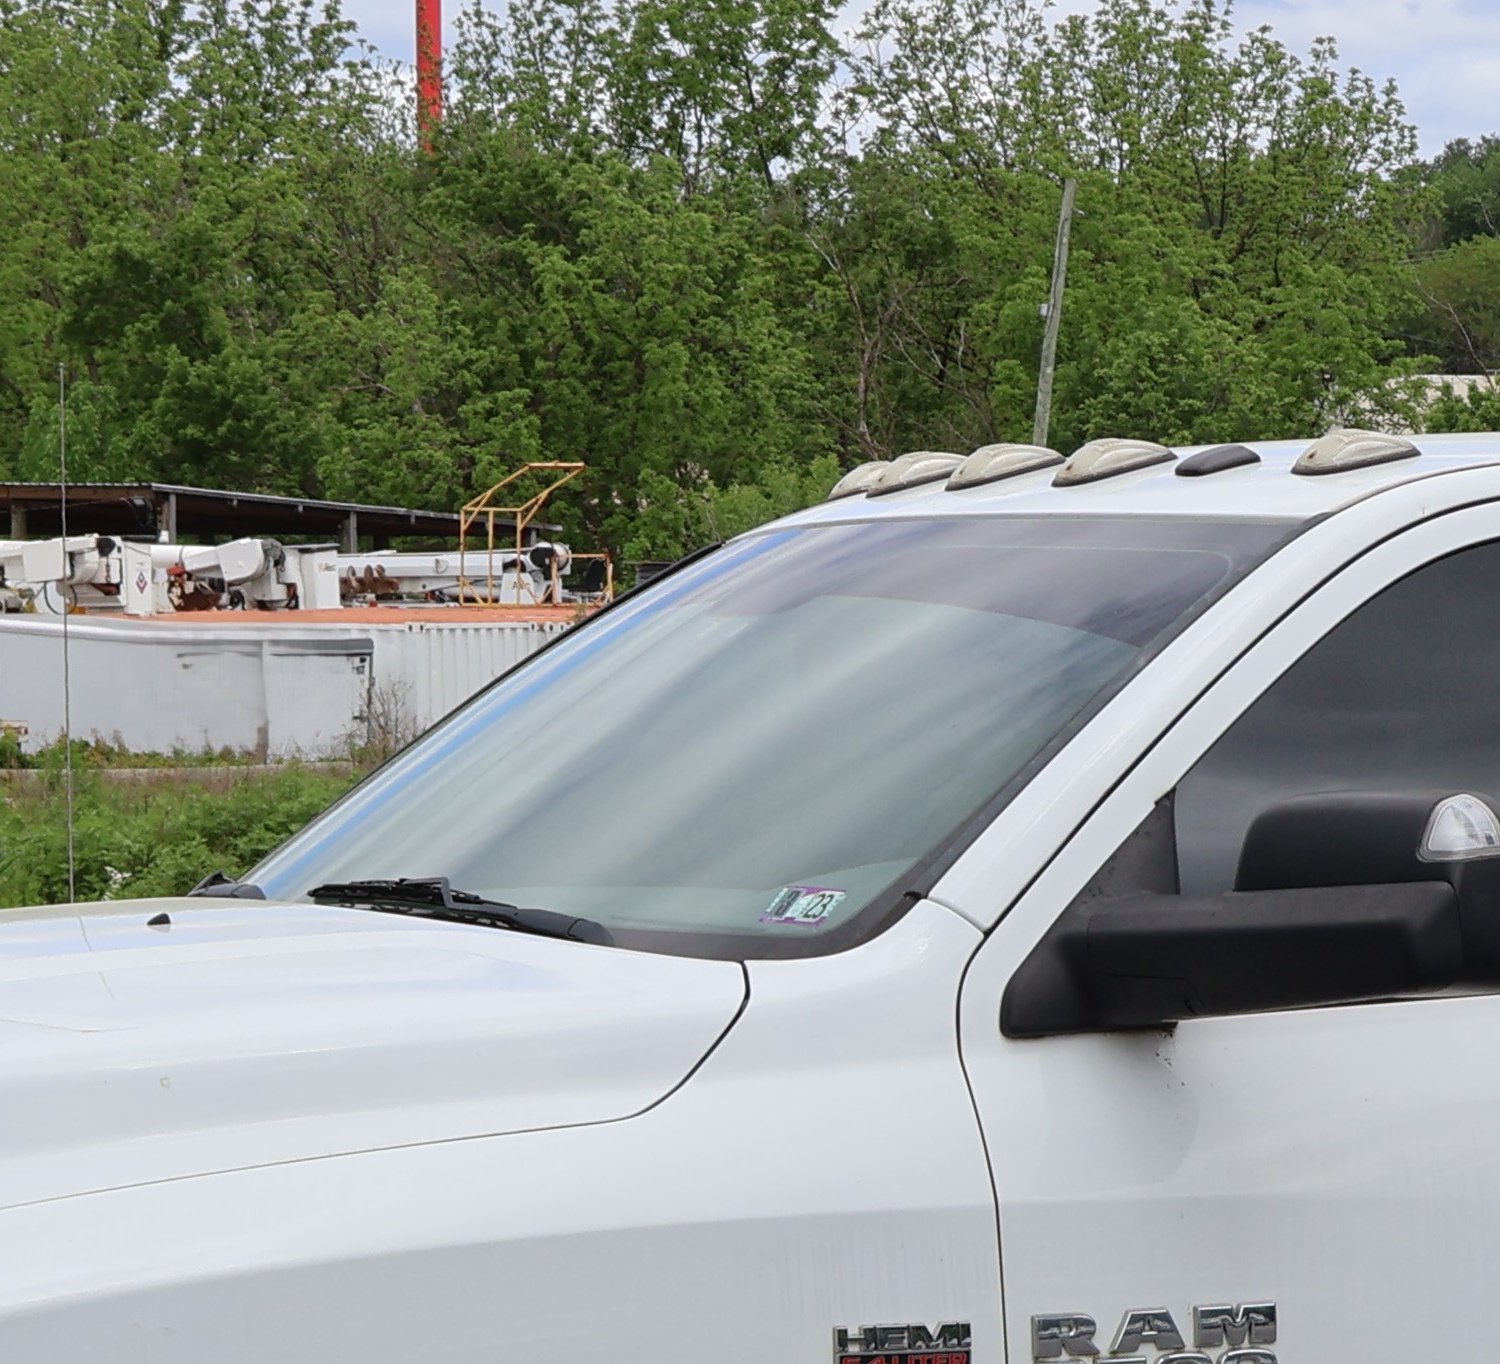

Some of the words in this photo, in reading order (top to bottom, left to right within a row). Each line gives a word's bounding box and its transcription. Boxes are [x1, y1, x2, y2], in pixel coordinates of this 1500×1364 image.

[802, 893, 835, 918] 23
[833, 1321, 971, 1354] HEMI
[1031, 1302, 1277, 1357] RAM
